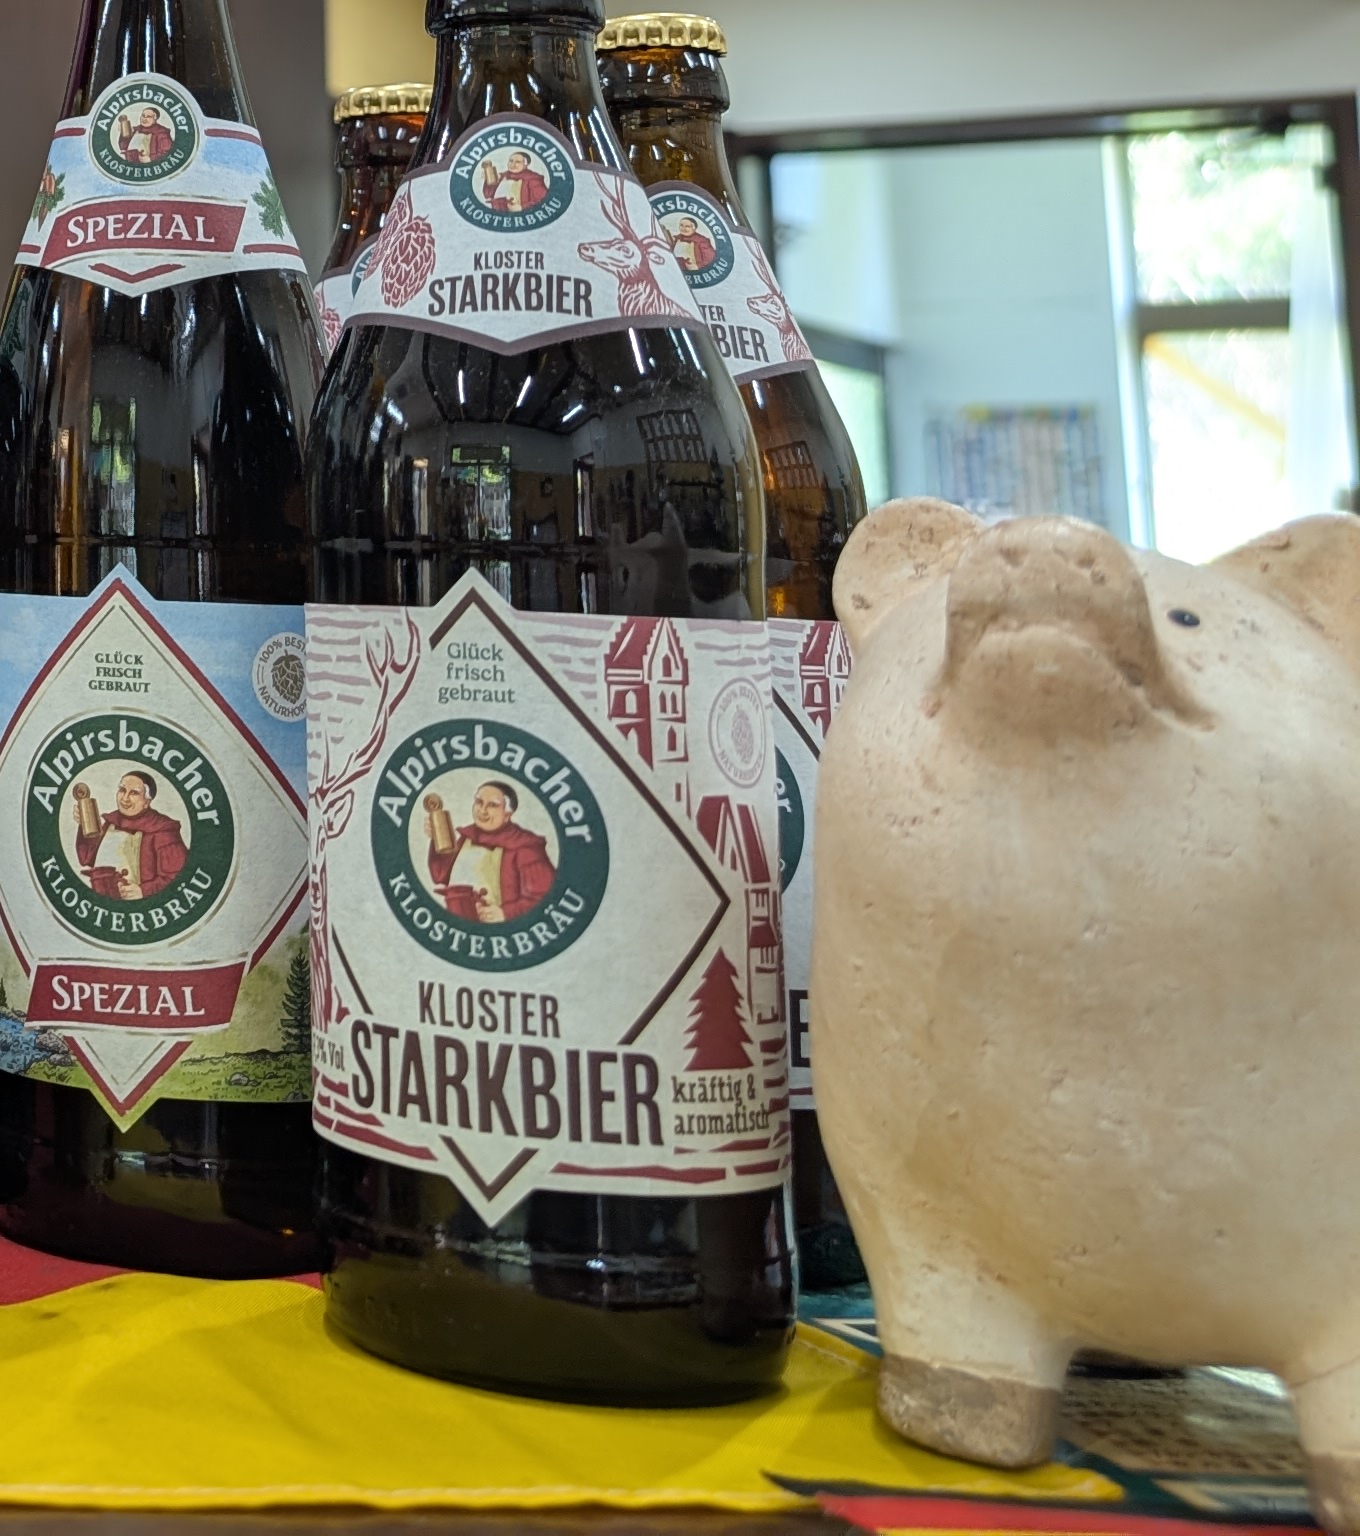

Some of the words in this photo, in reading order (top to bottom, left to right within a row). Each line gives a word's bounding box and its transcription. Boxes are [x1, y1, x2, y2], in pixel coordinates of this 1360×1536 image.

[96, 85, 190, 133] Alpirsbacher
[99, 148, 185, 178] KLOSTERBRÄU
[455, 128, 567, 181] Alpirsbacher
[460, 196, 563, 228] KLOSTERBRÄU
[66, 214, 215, 248] SPEZIAL
[473, 251, 545, 271] KLOSTER
[428, 273, 594, 318] STARKBIER
[94, 650, 145, 665] GLÜCK
[259, 639, 283, 663] 100%
[284, 636, 307, 656] BEST
[446, 641, 504, 662] Glück
[88, 680, 152, 694] GEBRAUT
[95, 665, 144, 680] FRISCH
[445, 662, 506, 683] frisch
[437, 683, 516, 706] gebraut
[33, 720, 221, 827] Alpirsbacher
[378, 724, 593, 846] Alpirsbacher
[40, 855, 214, 934] KLOSTERBRÄU
[388, 870, 587, 961] KLOSTERBRÄU
[51, 975, 206, 1017] SPEZIAL
[418, 980, 561, 1039] KLOSTER
[328, 1041, 346, 1072] Vol
[351, 1020, 665, 1148] STARKBIER
[671, 1074, 743, 1107] kräftig
[746, 1072, 756, 1101] &
[674, 1102, 771, 1136] aromatisch
